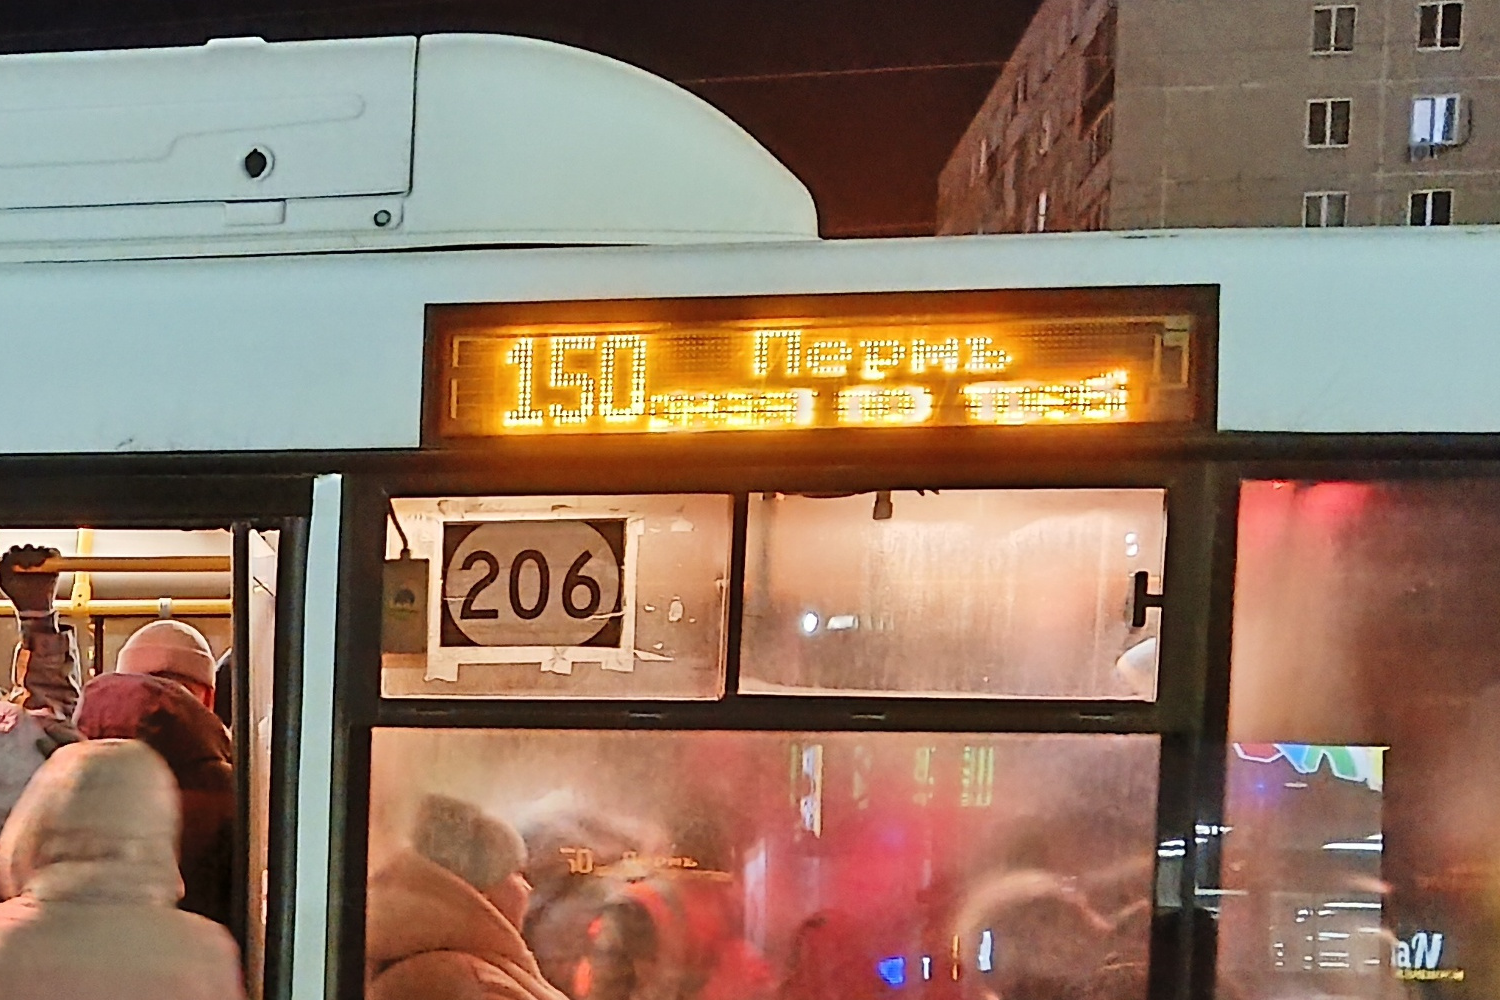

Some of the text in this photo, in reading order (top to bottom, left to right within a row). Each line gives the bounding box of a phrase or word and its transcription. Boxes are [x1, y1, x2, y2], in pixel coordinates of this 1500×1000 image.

[504, 336, 647, 427] 150
[753, 329, 1013, 381] Пермь
[460, 549, 601, 620] 206
